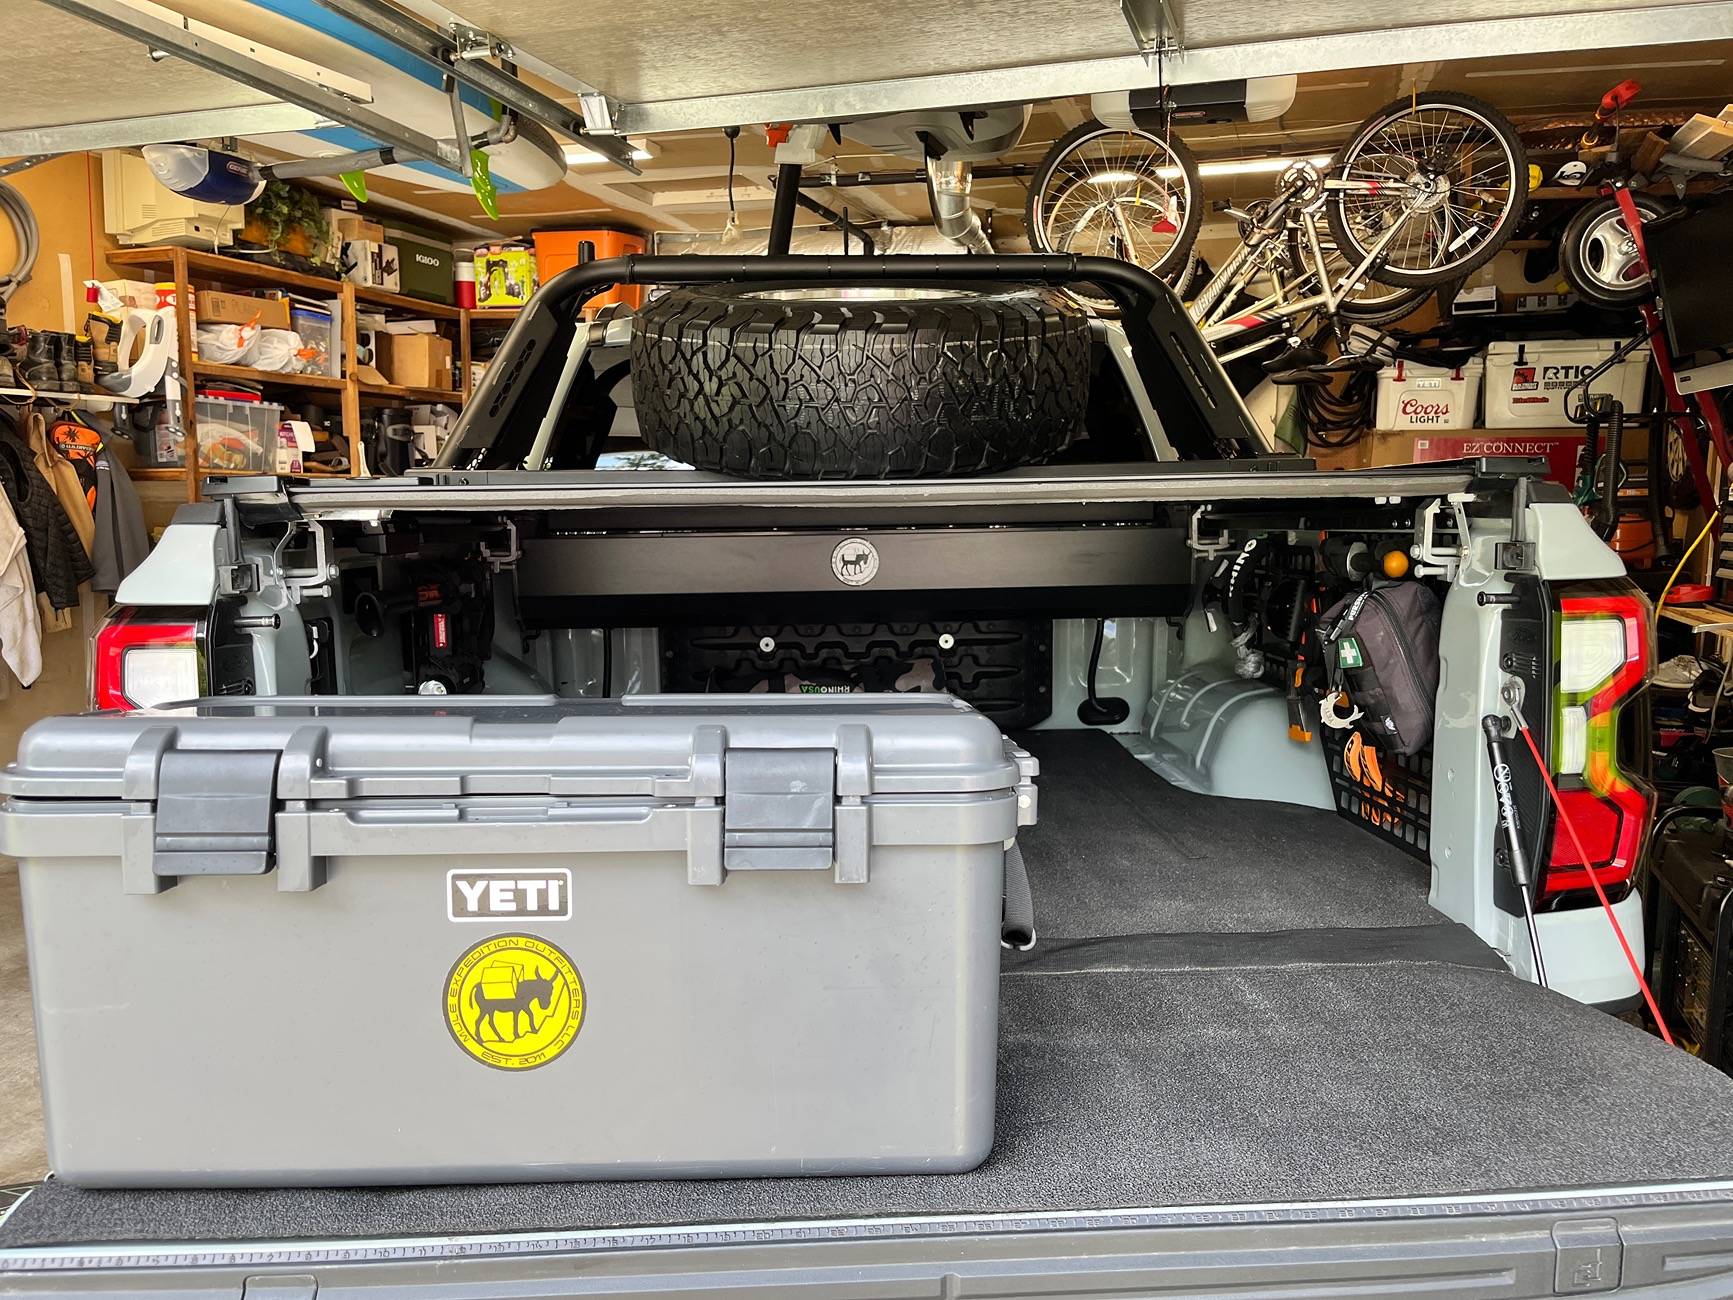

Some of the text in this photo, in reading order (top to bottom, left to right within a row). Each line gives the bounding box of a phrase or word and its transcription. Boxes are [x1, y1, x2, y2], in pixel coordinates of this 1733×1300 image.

[1401, 398, 1450, 416] Coors
[1409, 415, 1441, 424] LIGHT
[455, 880, 561, 912] YETI
[449, 938, 581, 1050] MULE EXPEDITION OUTFITTERS LLC
[481, 1051, 547, 1066] EST. 2011
